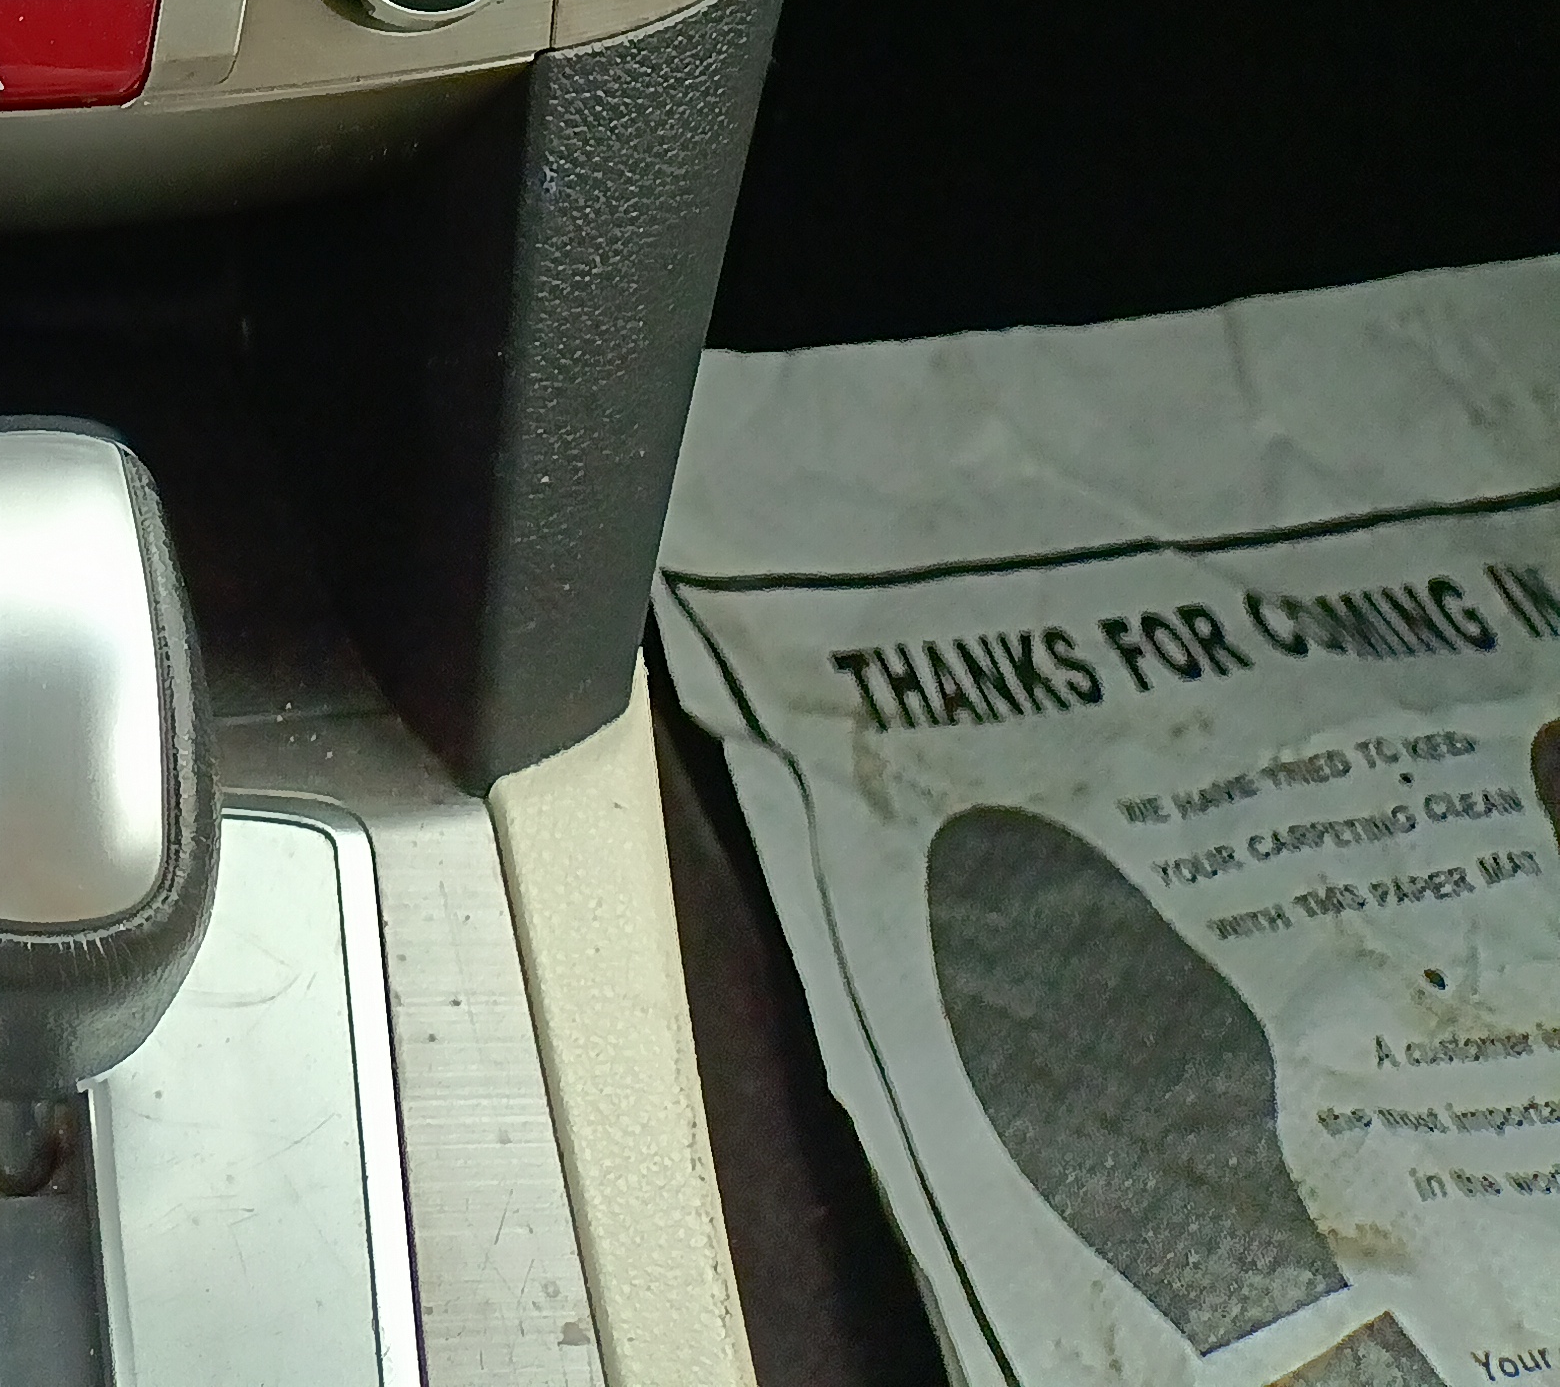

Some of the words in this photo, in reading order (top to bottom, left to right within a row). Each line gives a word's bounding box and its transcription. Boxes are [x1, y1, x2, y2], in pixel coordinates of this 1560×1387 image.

[829, 627, 1105, 731] THANKS
[1095, 601, 1254, 691] FOR
[1151, 844, 1243, 888] YOUR
[1423, 788, 1524, 824] CLEAN
[1373, 1034, 1401, 1071] A
[1470, 1347, 1552, 1382] Your
